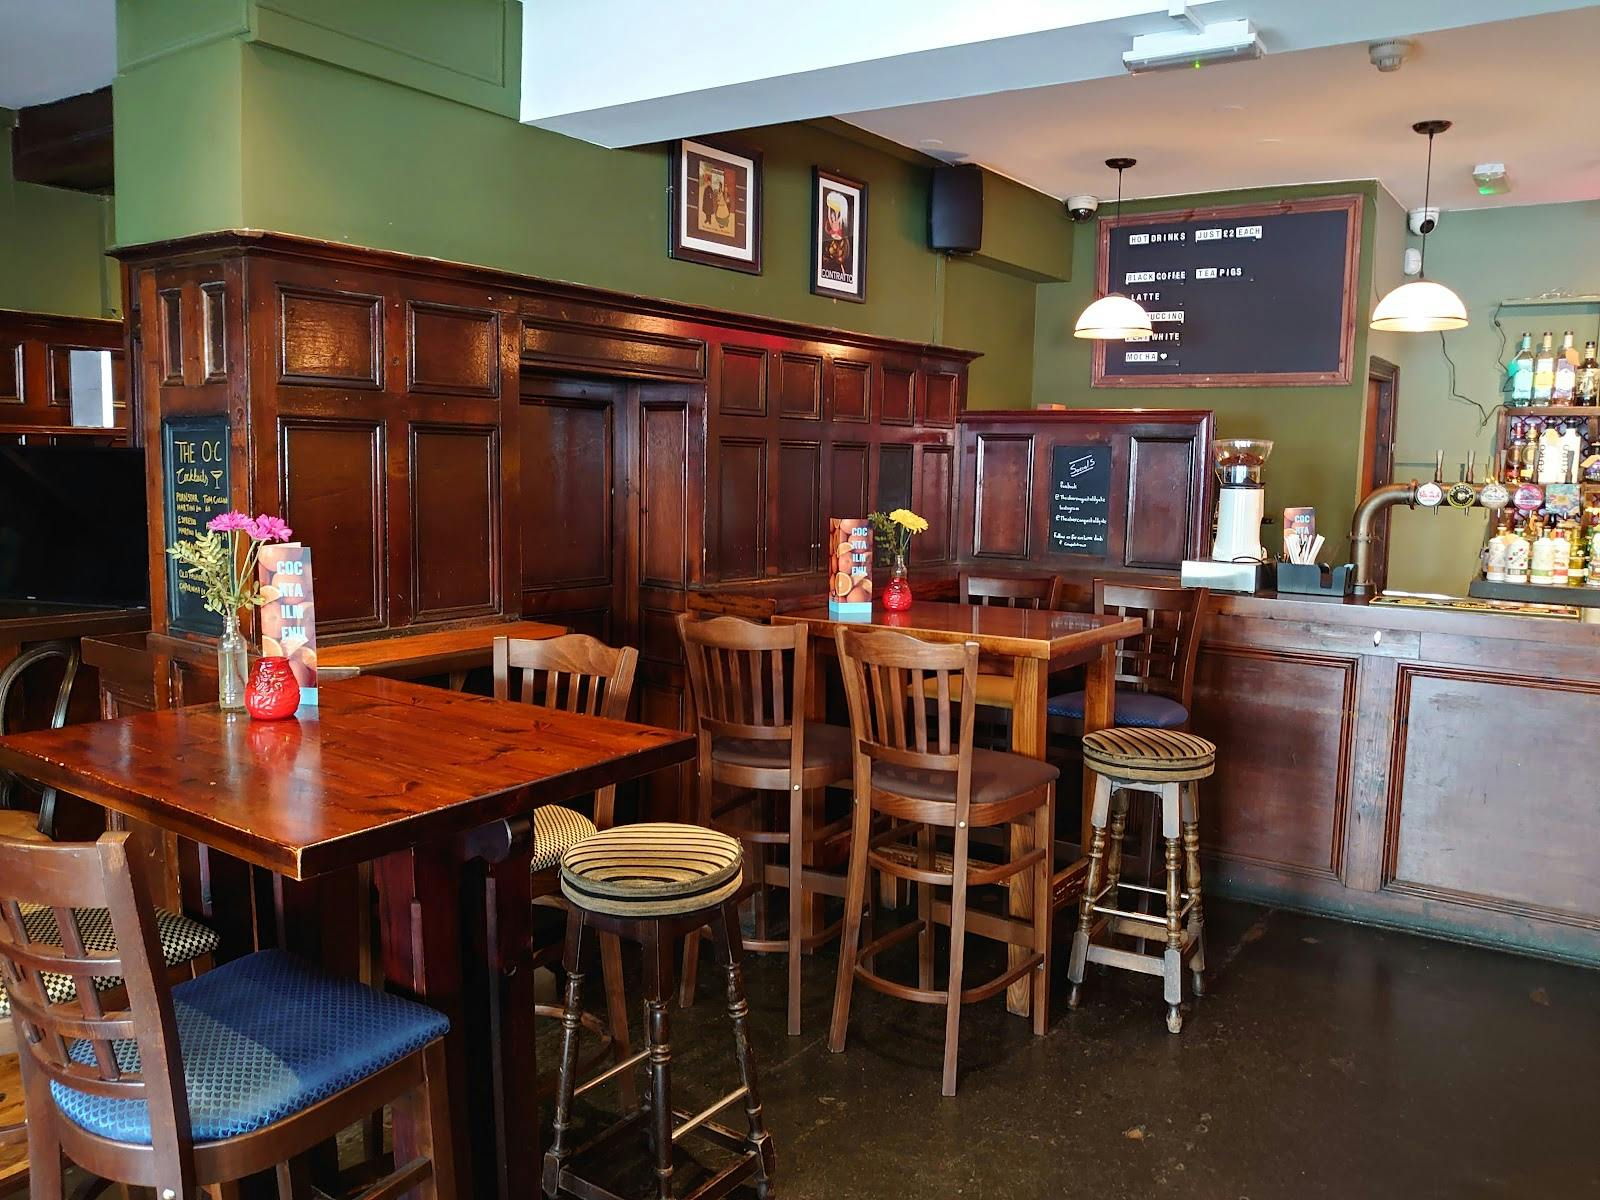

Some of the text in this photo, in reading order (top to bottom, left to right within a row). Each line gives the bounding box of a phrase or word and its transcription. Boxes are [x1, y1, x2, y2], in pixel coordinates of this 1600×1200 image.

[1130, 227, 1261, 244] HOT DRINKS JUST £2 EACH
[821, 269, 854, 284] CONTRATTO
[1198, 267, 1242, 278] TEA PIGS
[1131, 292, 1160, 301] LATTE
[1146, 312, 1183, 321] UCCINO
[1152, 332, 1180, 341] WHITE
[1126, 353, 1157, 361] MOCHA
[174, 441, 196, 463] THE
[1295, 515, 1310, 523] COC
[851, 527, 868, 536] COC
[276, 561, 303, 575] COC
[278, 582, 304, 597] KTA
